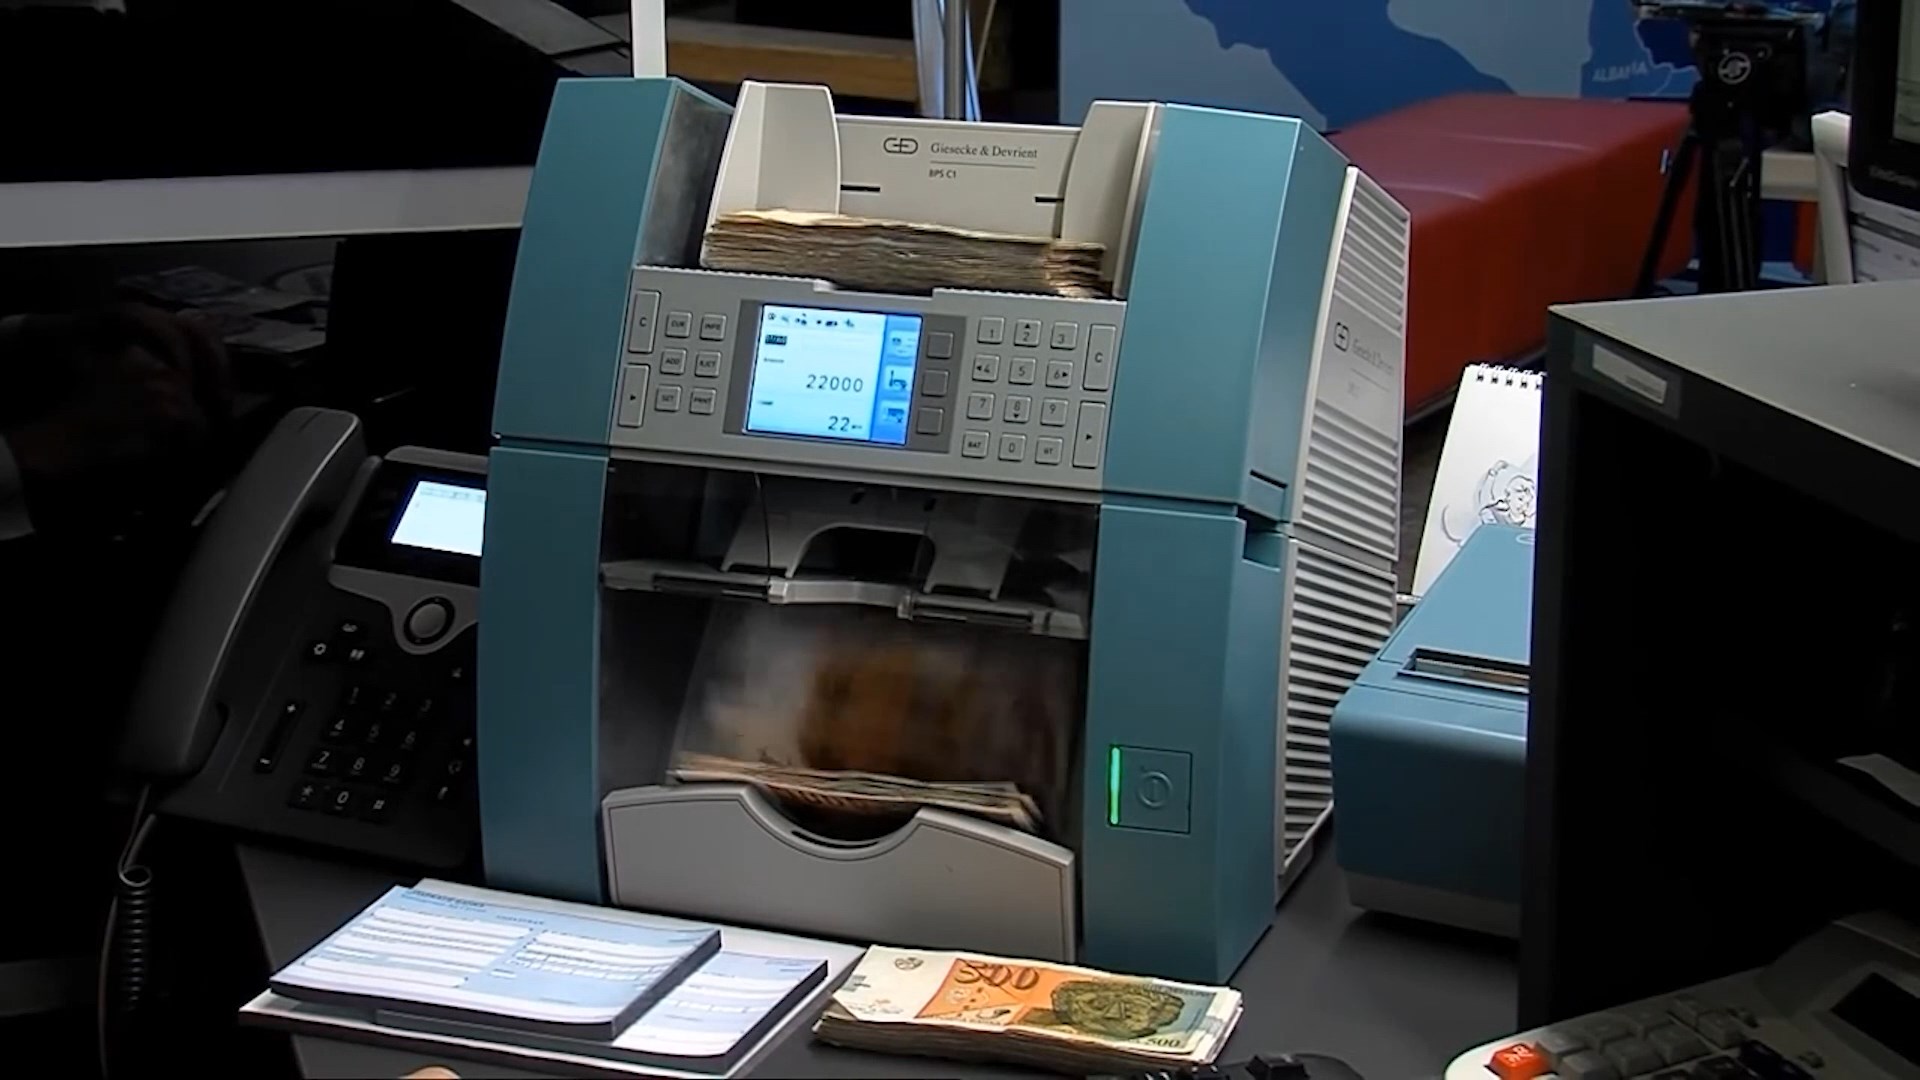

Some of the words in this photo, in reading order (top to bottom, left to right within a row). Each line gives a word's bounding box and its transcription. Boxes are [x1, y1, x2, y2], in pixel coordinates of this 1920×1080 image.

[930, 142, 978, 156] Giesecke
[980, 144, 989, 156] &
[992, 145, 1038, 159] Devrient
[928, 168, 945, 178] BPS
[946, 169, 957, 179] C1
[639, 317, 648, 327] C
[1023, 331, 1031, 342] 2
[1057, 334, 1065, 344] 3
[1094, 352, 1103, 363] C
[983, 363, 991, 373] 4
[1018, 366, 1026, 377] 5
[806, 374, 864, 393] 22000
[979, 398, 987, 409] 7
[1013, 401, 1021, 411] 8
[1049, 403, 1057, 414] 9
[828, 415, 851, 433] 22
[353, 756, 366, 771] 8
[388, 763, 401, 777] 9
[337, 790, 350, 804] 0
[953, 959, 1041, 991] 500
[1146, 1038, 1182, 1049] 500
